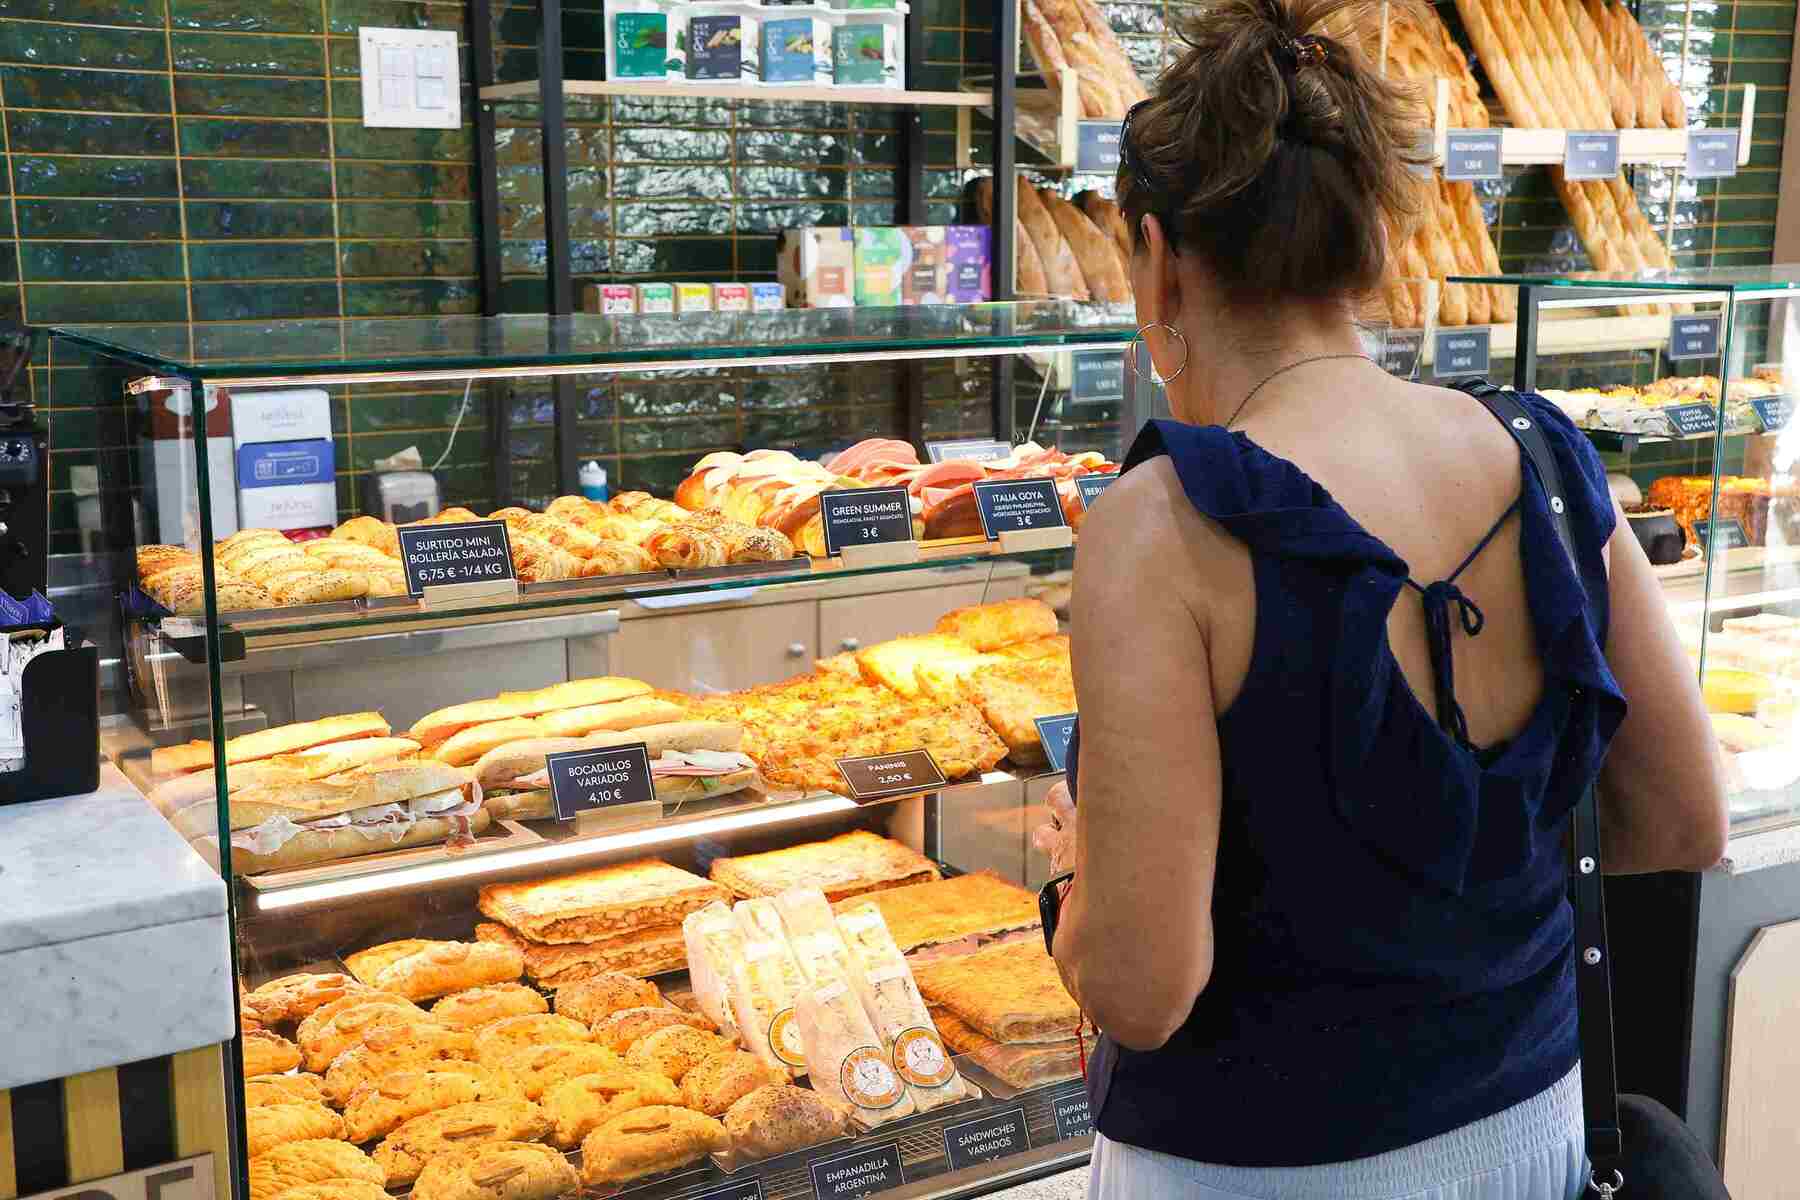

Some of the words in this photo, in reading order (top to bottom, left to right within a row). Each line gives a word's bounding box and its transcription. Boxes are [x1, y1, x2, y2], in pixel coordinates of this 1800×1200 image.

[992, 493, 1018, 503] ITALIA
[1018, 491, 1043, 500] GOYA
[832, 505, 862, 516] GREEN
[863, 502, 902, 514] SUMMER
[1017, 517, 1024, 526] 3
[1025, 516, 1032, 525] €
[862, 528, 869, 538] 3
[871, 527, 878, 537] €
[416, 538, 463, 551] SURTIDO
[465, 536, 490, 547] MINI
[410, 549, 460, 564] BOLLERÍA
[462, 547, 504, 559] SALADA
[418, 568, 445, 581] 6,75
[447, 567, 456, 577] €
[484, 563, 502, 574] KG
[568, 760, 632, 777] BOCADILLOS
[576, 772, 630, 787] VARIADOS
[878, 774, 902, 785] 2,50
[588, 790, 611, 803] 4,10
[614, 789, 623, 799] €
[967, 1137, 1012, 1156] VARIADOS
[826, 1158, 889, 1183] EMPANADILLA
[834, 1171, 887, 1193] ARGENTINA
